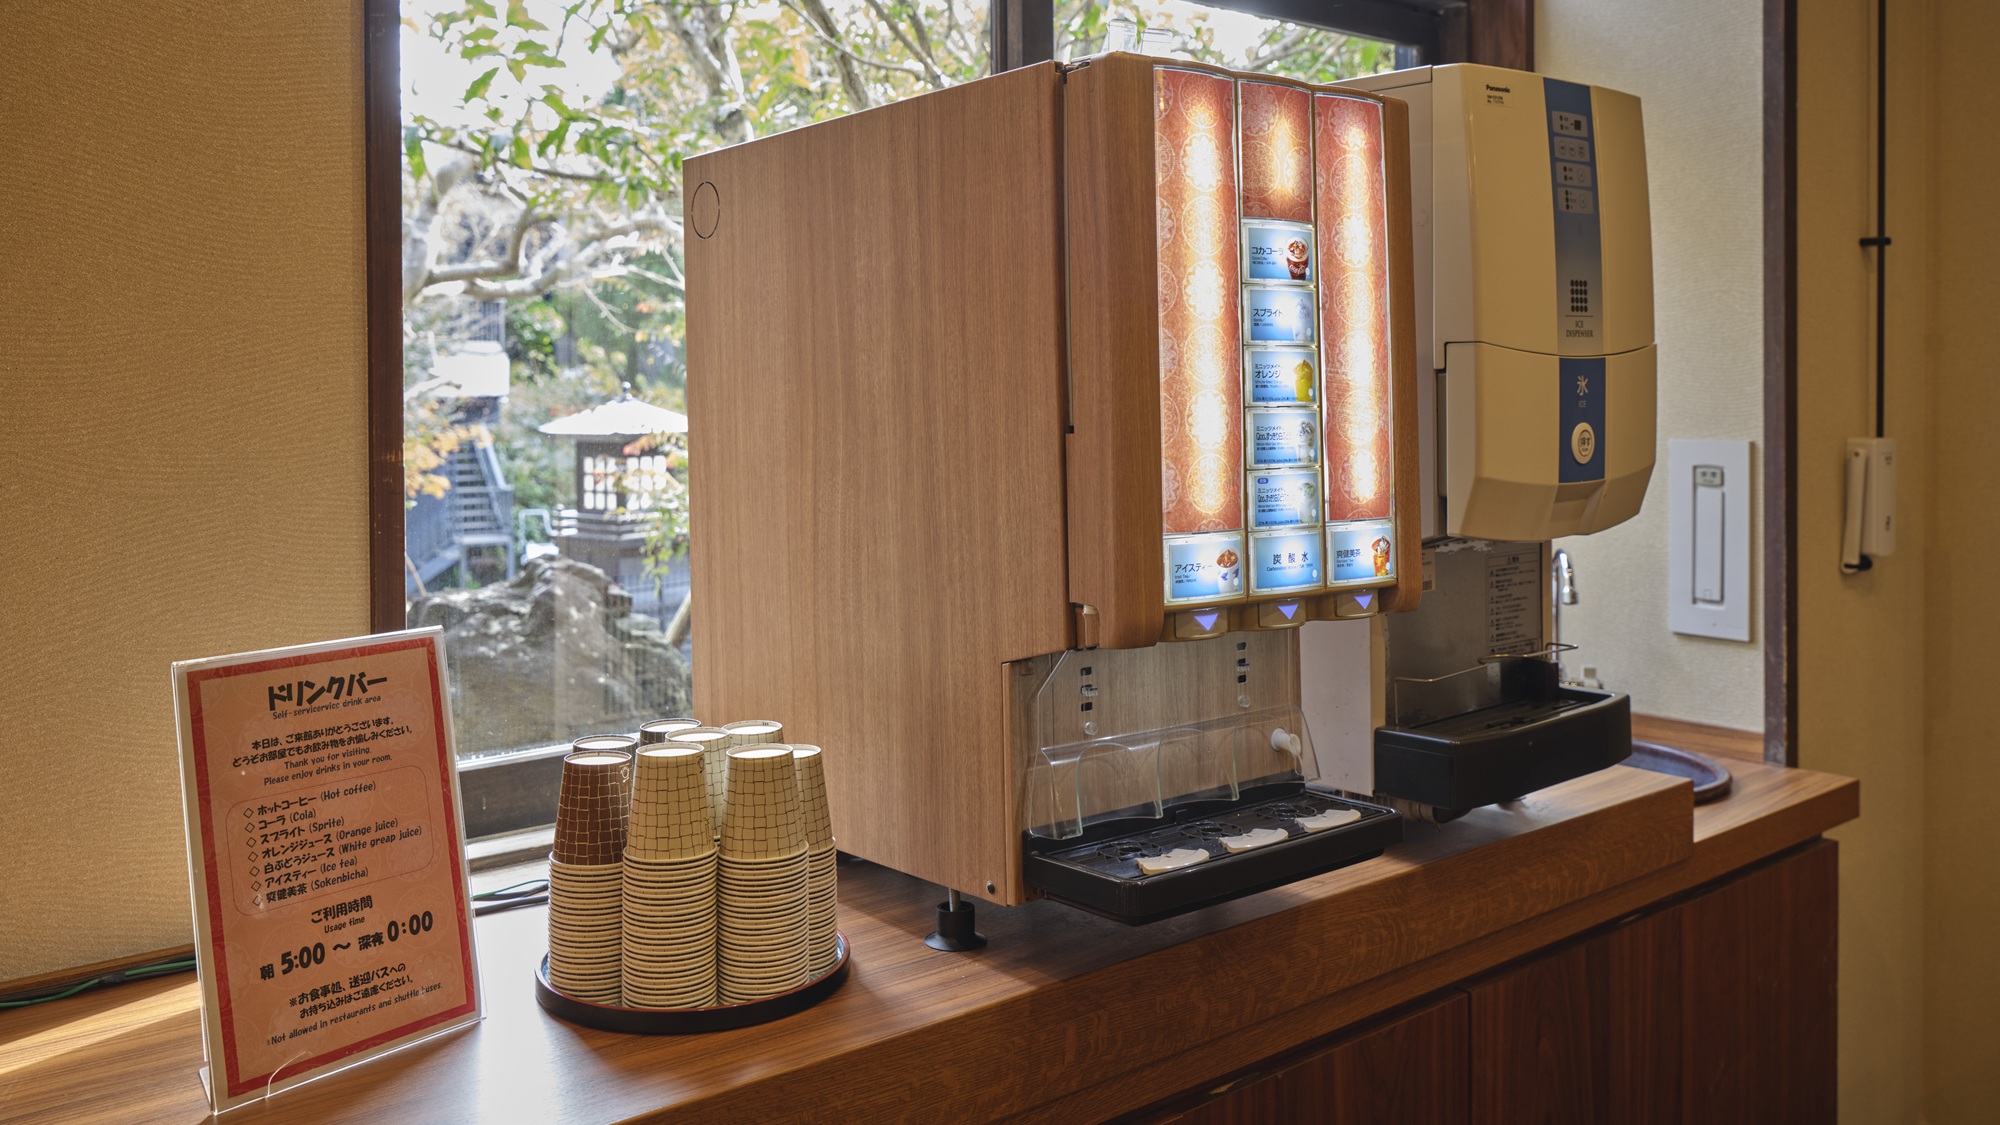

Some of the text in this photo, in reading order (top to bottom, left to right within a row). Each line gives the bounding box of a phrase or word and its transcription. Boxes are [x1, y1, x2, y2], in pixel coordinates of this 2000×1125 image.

[1486, 84, 1510, 93] Panasonic
[1253, 308, 1283, 317] スプライト
[1575, 320, 1584, 328] ICE
[1566, 329, 1594, 338] DISPENSER
[1255, 370, 1280, 378] オレンジ
[1576, 375, 1588, 396] 氷
[1578, 400, 1586, 408] ICE
[1175, 563, 1213, 573] アイスティー
[268, 672, 387, 711] ドリンクバー
[343, 699, 362, 708] drink
[365, 695, 381, 704] area
[232, 726, 413, 768] どうぞお部屋でもお飲み物をお愉しみください。
[252, 716, 395, 751] 本日は、ご来館ありがとうございます。
[264, 754, 392, 786] Please enjoy drinks in your room.
[284, 746, 372, 770] Thank you for visiting.
[257, 781, 376, 816] ホットコーヒー (Hot coffee)
[258, 808, 316, 830] コーラ (Cola)
[260, 816, 344, 845] スプライト (Sprite)
[262, 818, 398, 859] オレンジジュース (Orange juice)
[264, 826, 422, 875] 白ぶどうジュース (White greap juice)
[265, 856, 358, 888] アイスティー (Ice tea)
[266, 867, 368, 903] 爽健美茶 (Sokenbicha)
[311, 895, 373, 924] ご利用時間
[324, 916, 365, 933] Usage time
[260, 964, 274, 981] 朝
[281, 943, 325, 975] 5:00
[358, 931, 384, 951] 深夜
[387, 911, 433, 942] 0:00
[289, 963, 406, 1007] ※お食事処、送迎バスへの
[300, 975, 413, 1019] お持ち込みはご遠慮ください。
[289, 1023, 317, 1039] allowed
[320, 1020, 328, 1029] in
[330, 1004, 375, 1025] restaurants
[379, 996, 392, 1009] and
[394, 989, 420, 1004] shuttle
